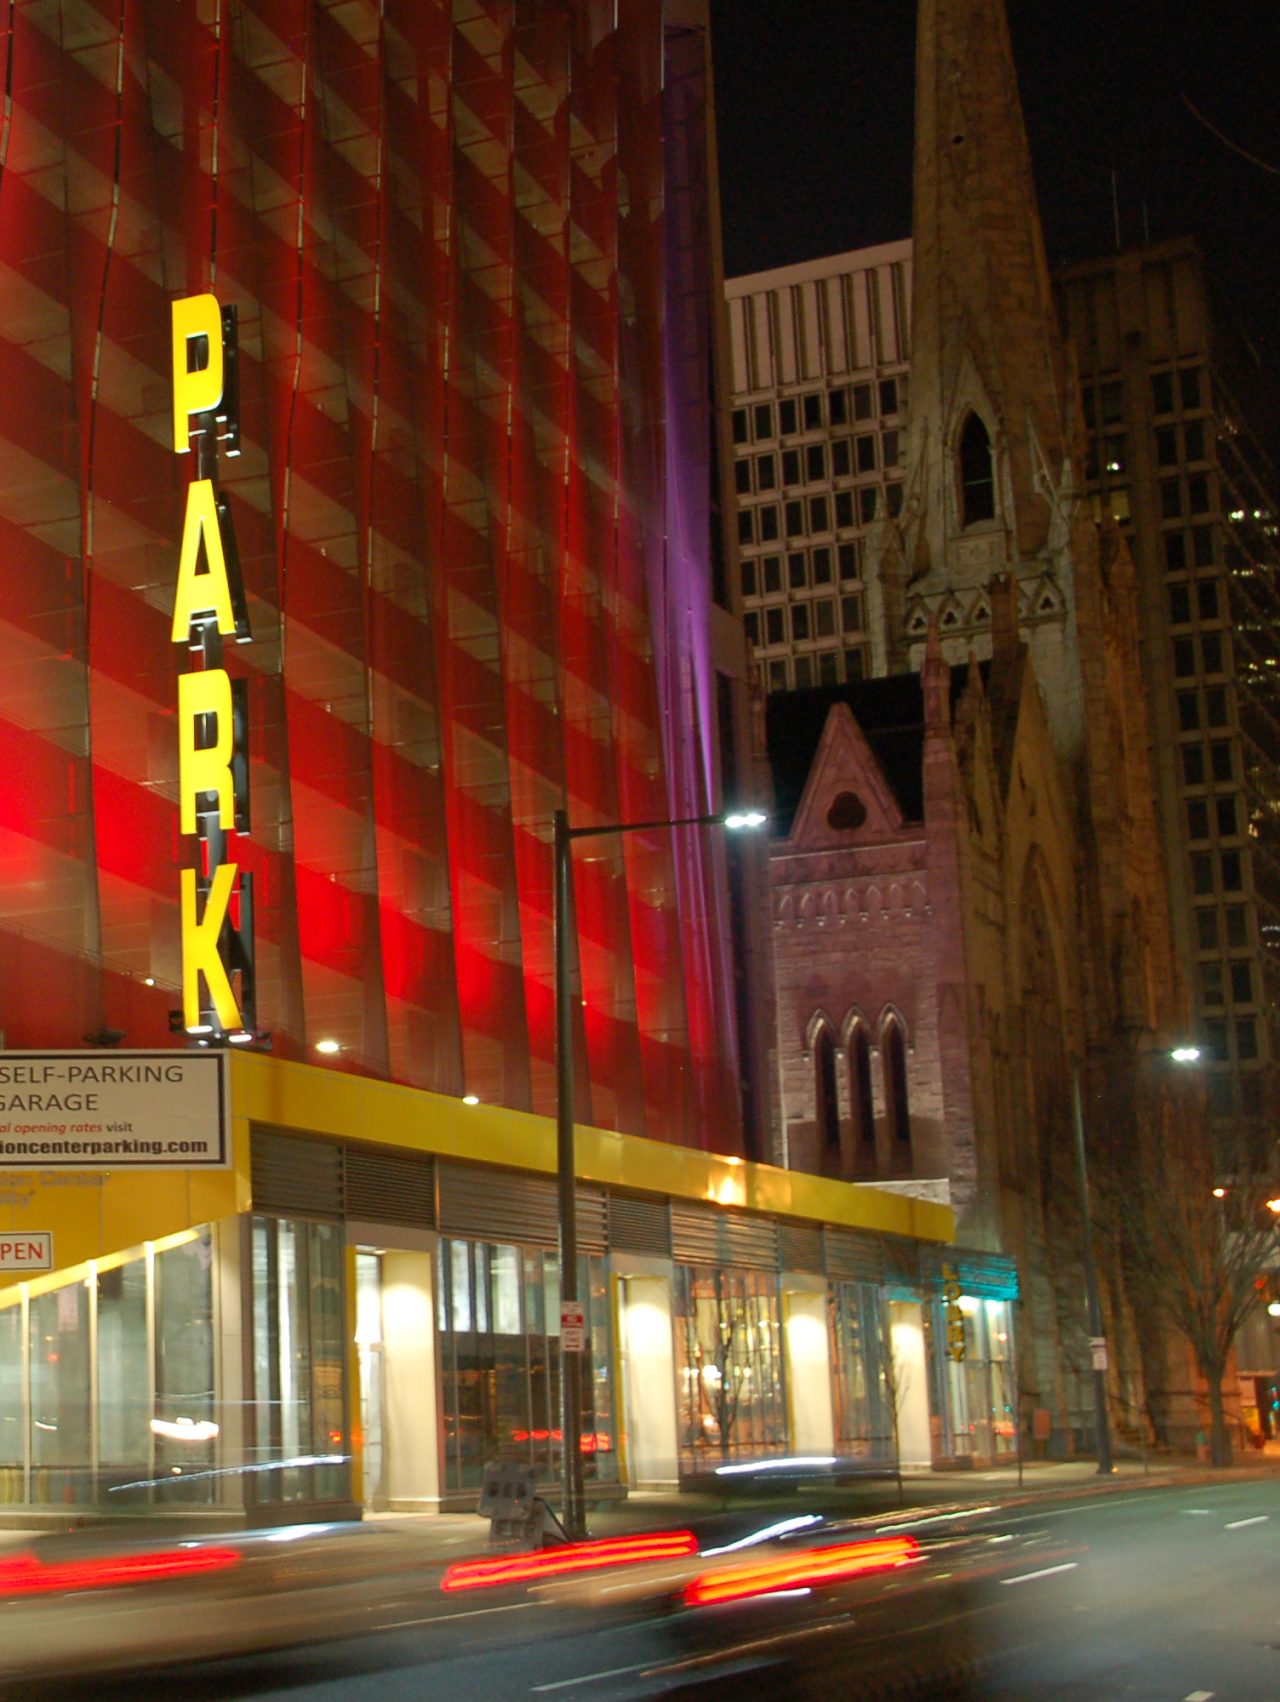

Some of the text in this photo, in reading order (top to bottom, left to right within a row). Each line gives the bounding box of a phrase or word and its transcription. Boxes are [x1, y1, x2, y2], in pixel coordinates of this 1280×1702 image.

[172, 293, 243, 1031] PARK
[14, 1121, 67, 1137] opening
[70, 1121, 103, 1134] rates
[106, 1120, 133, 1133] visit
